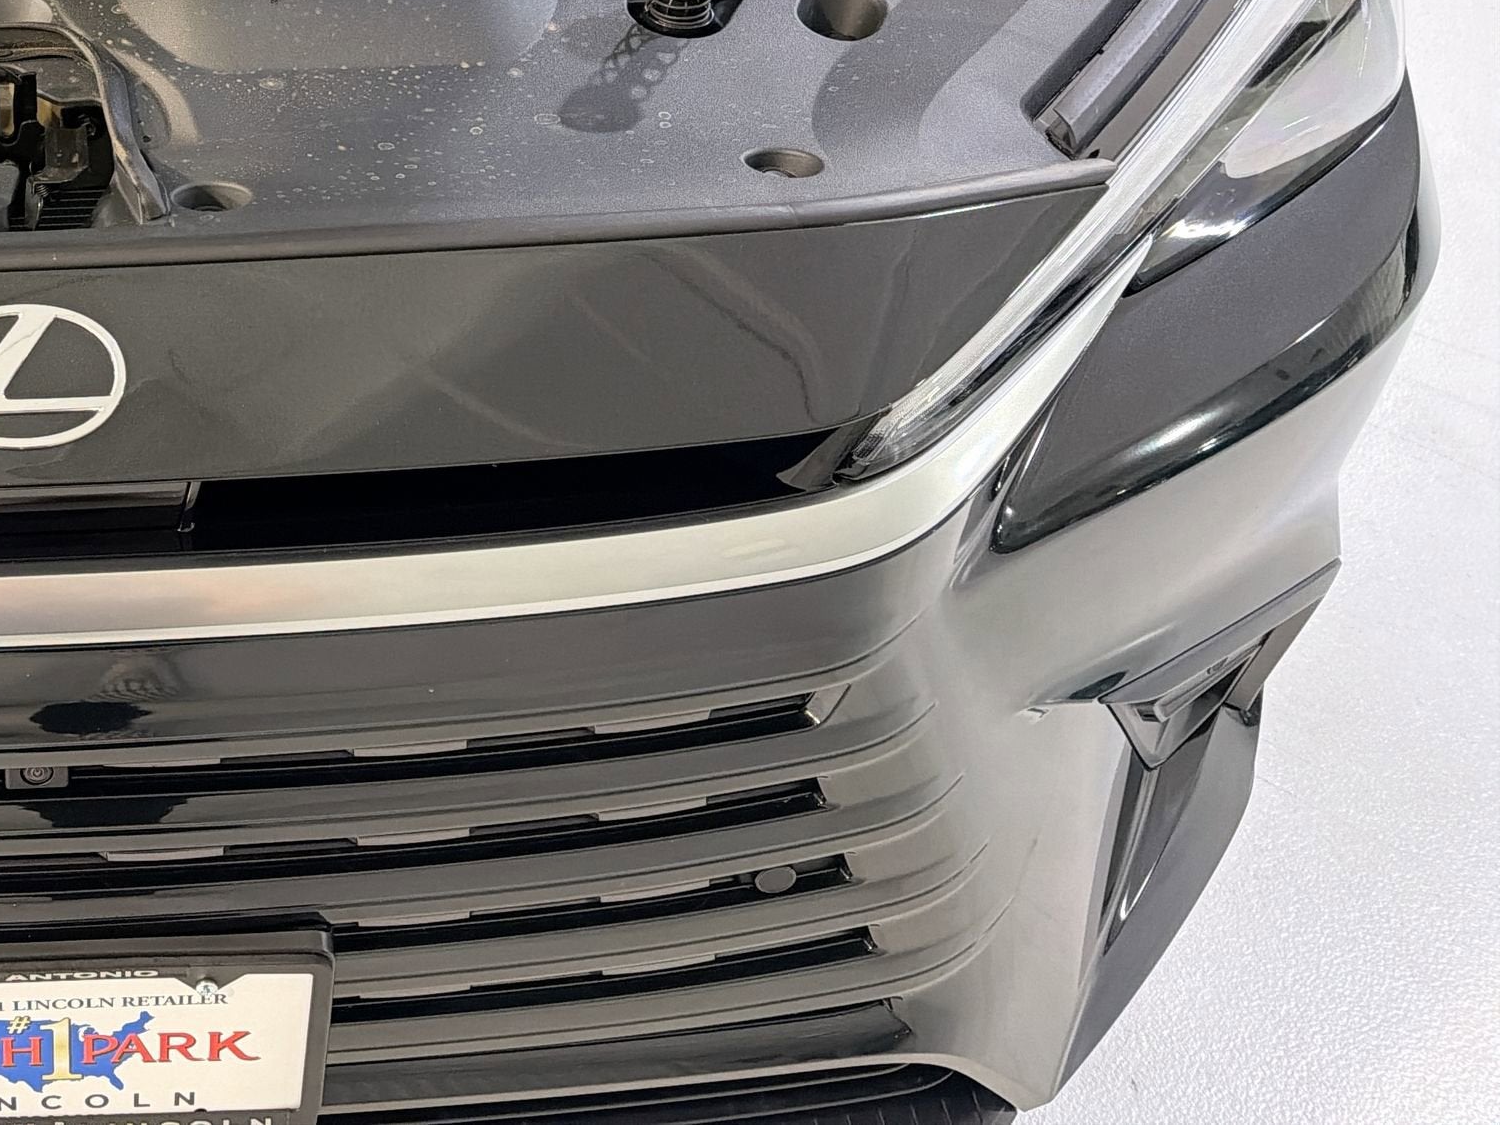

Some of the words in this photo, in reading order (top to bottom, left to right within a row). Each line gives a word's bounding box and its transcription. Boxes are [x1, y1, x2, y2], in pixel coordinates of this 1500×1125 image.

[5, 970, 159, 982] ANTONIO
[12, 997, 114, 1012] LINCOLN
[121, 993, 229, 1007] RETAILER
[81, 1030, 261, 1065] PARK
